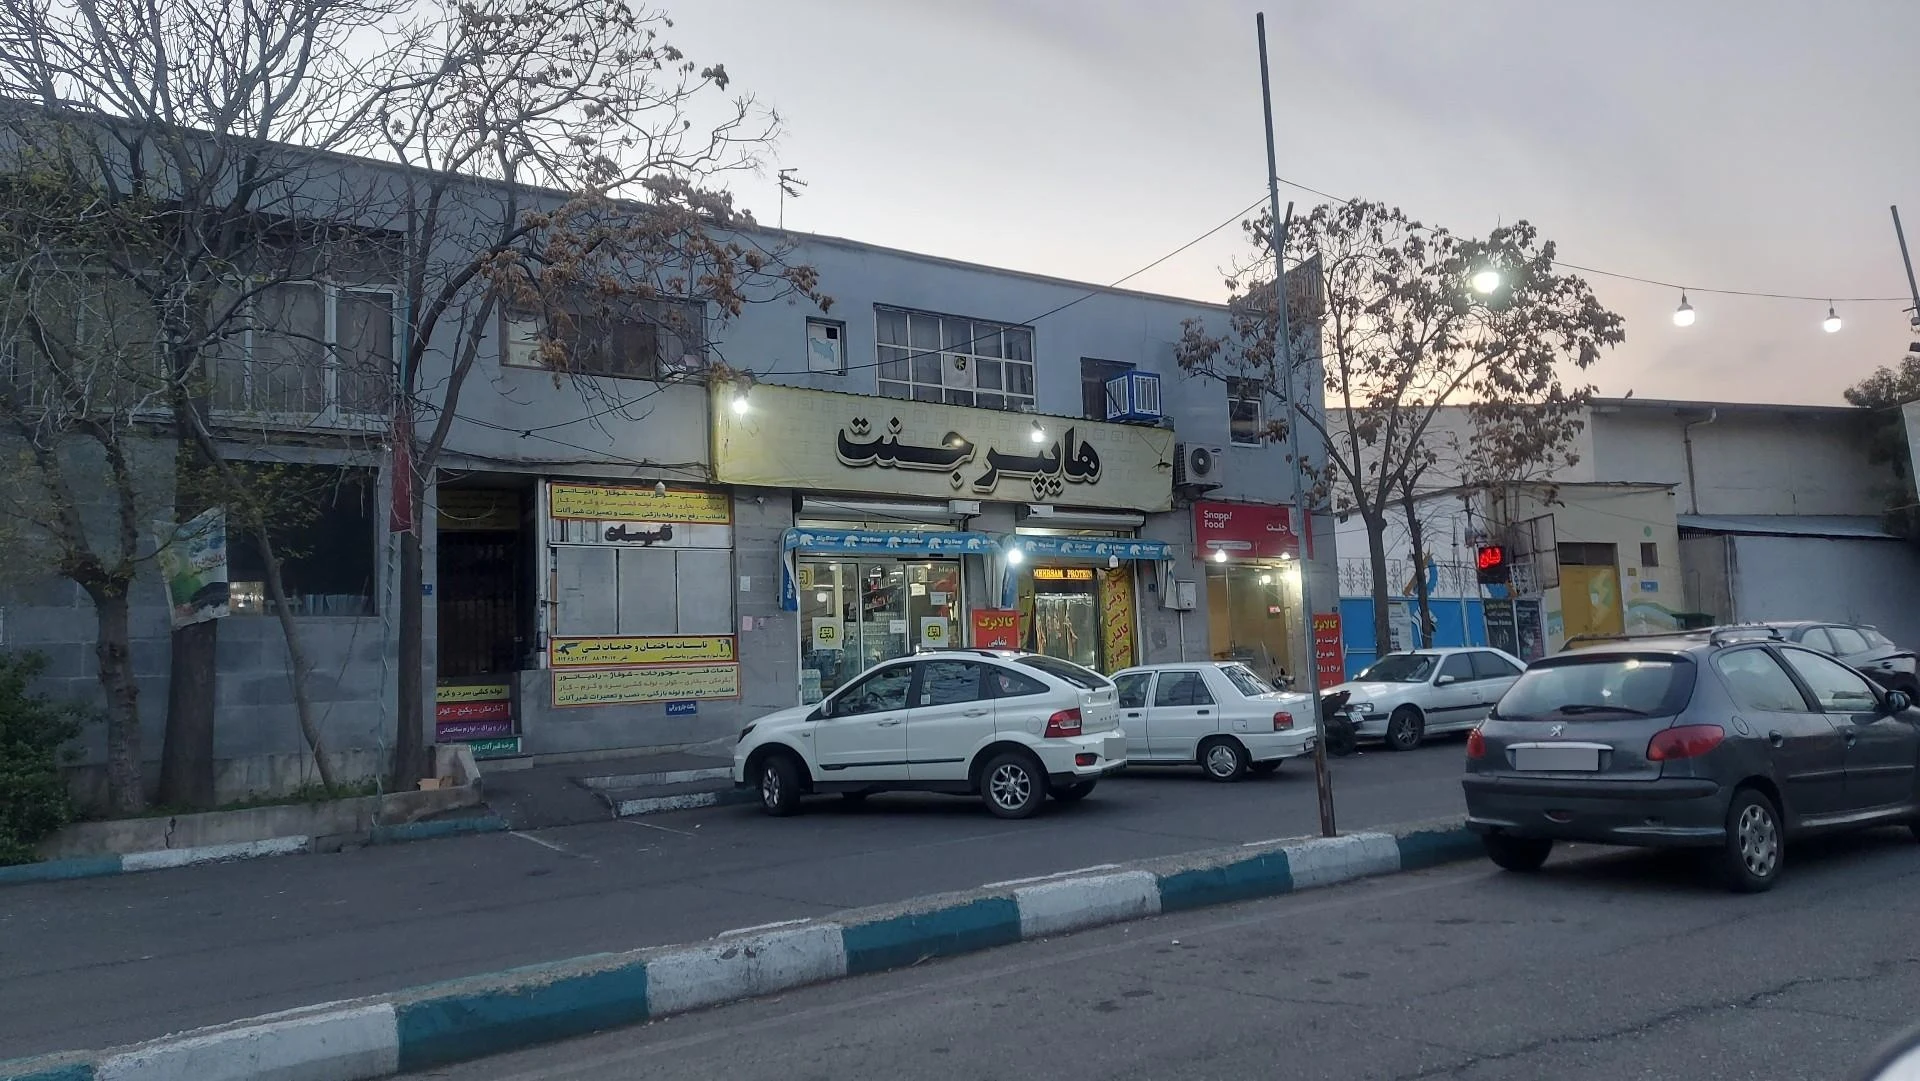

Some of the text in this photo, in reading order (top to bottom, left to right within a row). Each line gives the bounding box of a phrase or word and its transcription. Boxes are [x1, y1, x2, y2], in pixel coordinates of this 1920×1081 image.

[835, 416, 1102, 500] هایپر جنت
[555, 487, 598, 496] رادیاتور
[604, 489, 628, 497] شوفاژ
[1203, 510, 1232, 520] Snapp!
[1204, 520, 1225, 529] Food
[1266, 521, 1288, 535] جنت
[1066, 568, 1093, 579] PROTEIN
[1109, 623, 1129, 649] کالباس
[639, 641, 674, 652] ساختمان
[987, 636, 1008, 648] تمامی
[581, 642, 600, 654] فنی
[602, 643, 633, 651] خدمات
[558, 671, 602, 681] رادیاتور
[609, 671, 633, 679] شوفاژ
[640, 669, 680, 677] موتورخانه
[686, 667, 709, 676] فنی
[472, 689, 489, 697] کشی
[490, 687, 503, 695] لوله
[590, 692, 617, 701] تعمیرات
[437, 704, 504, 716] آبگرمکن پکیج کولر
[439, 727, 462, 735] ساختمانی
